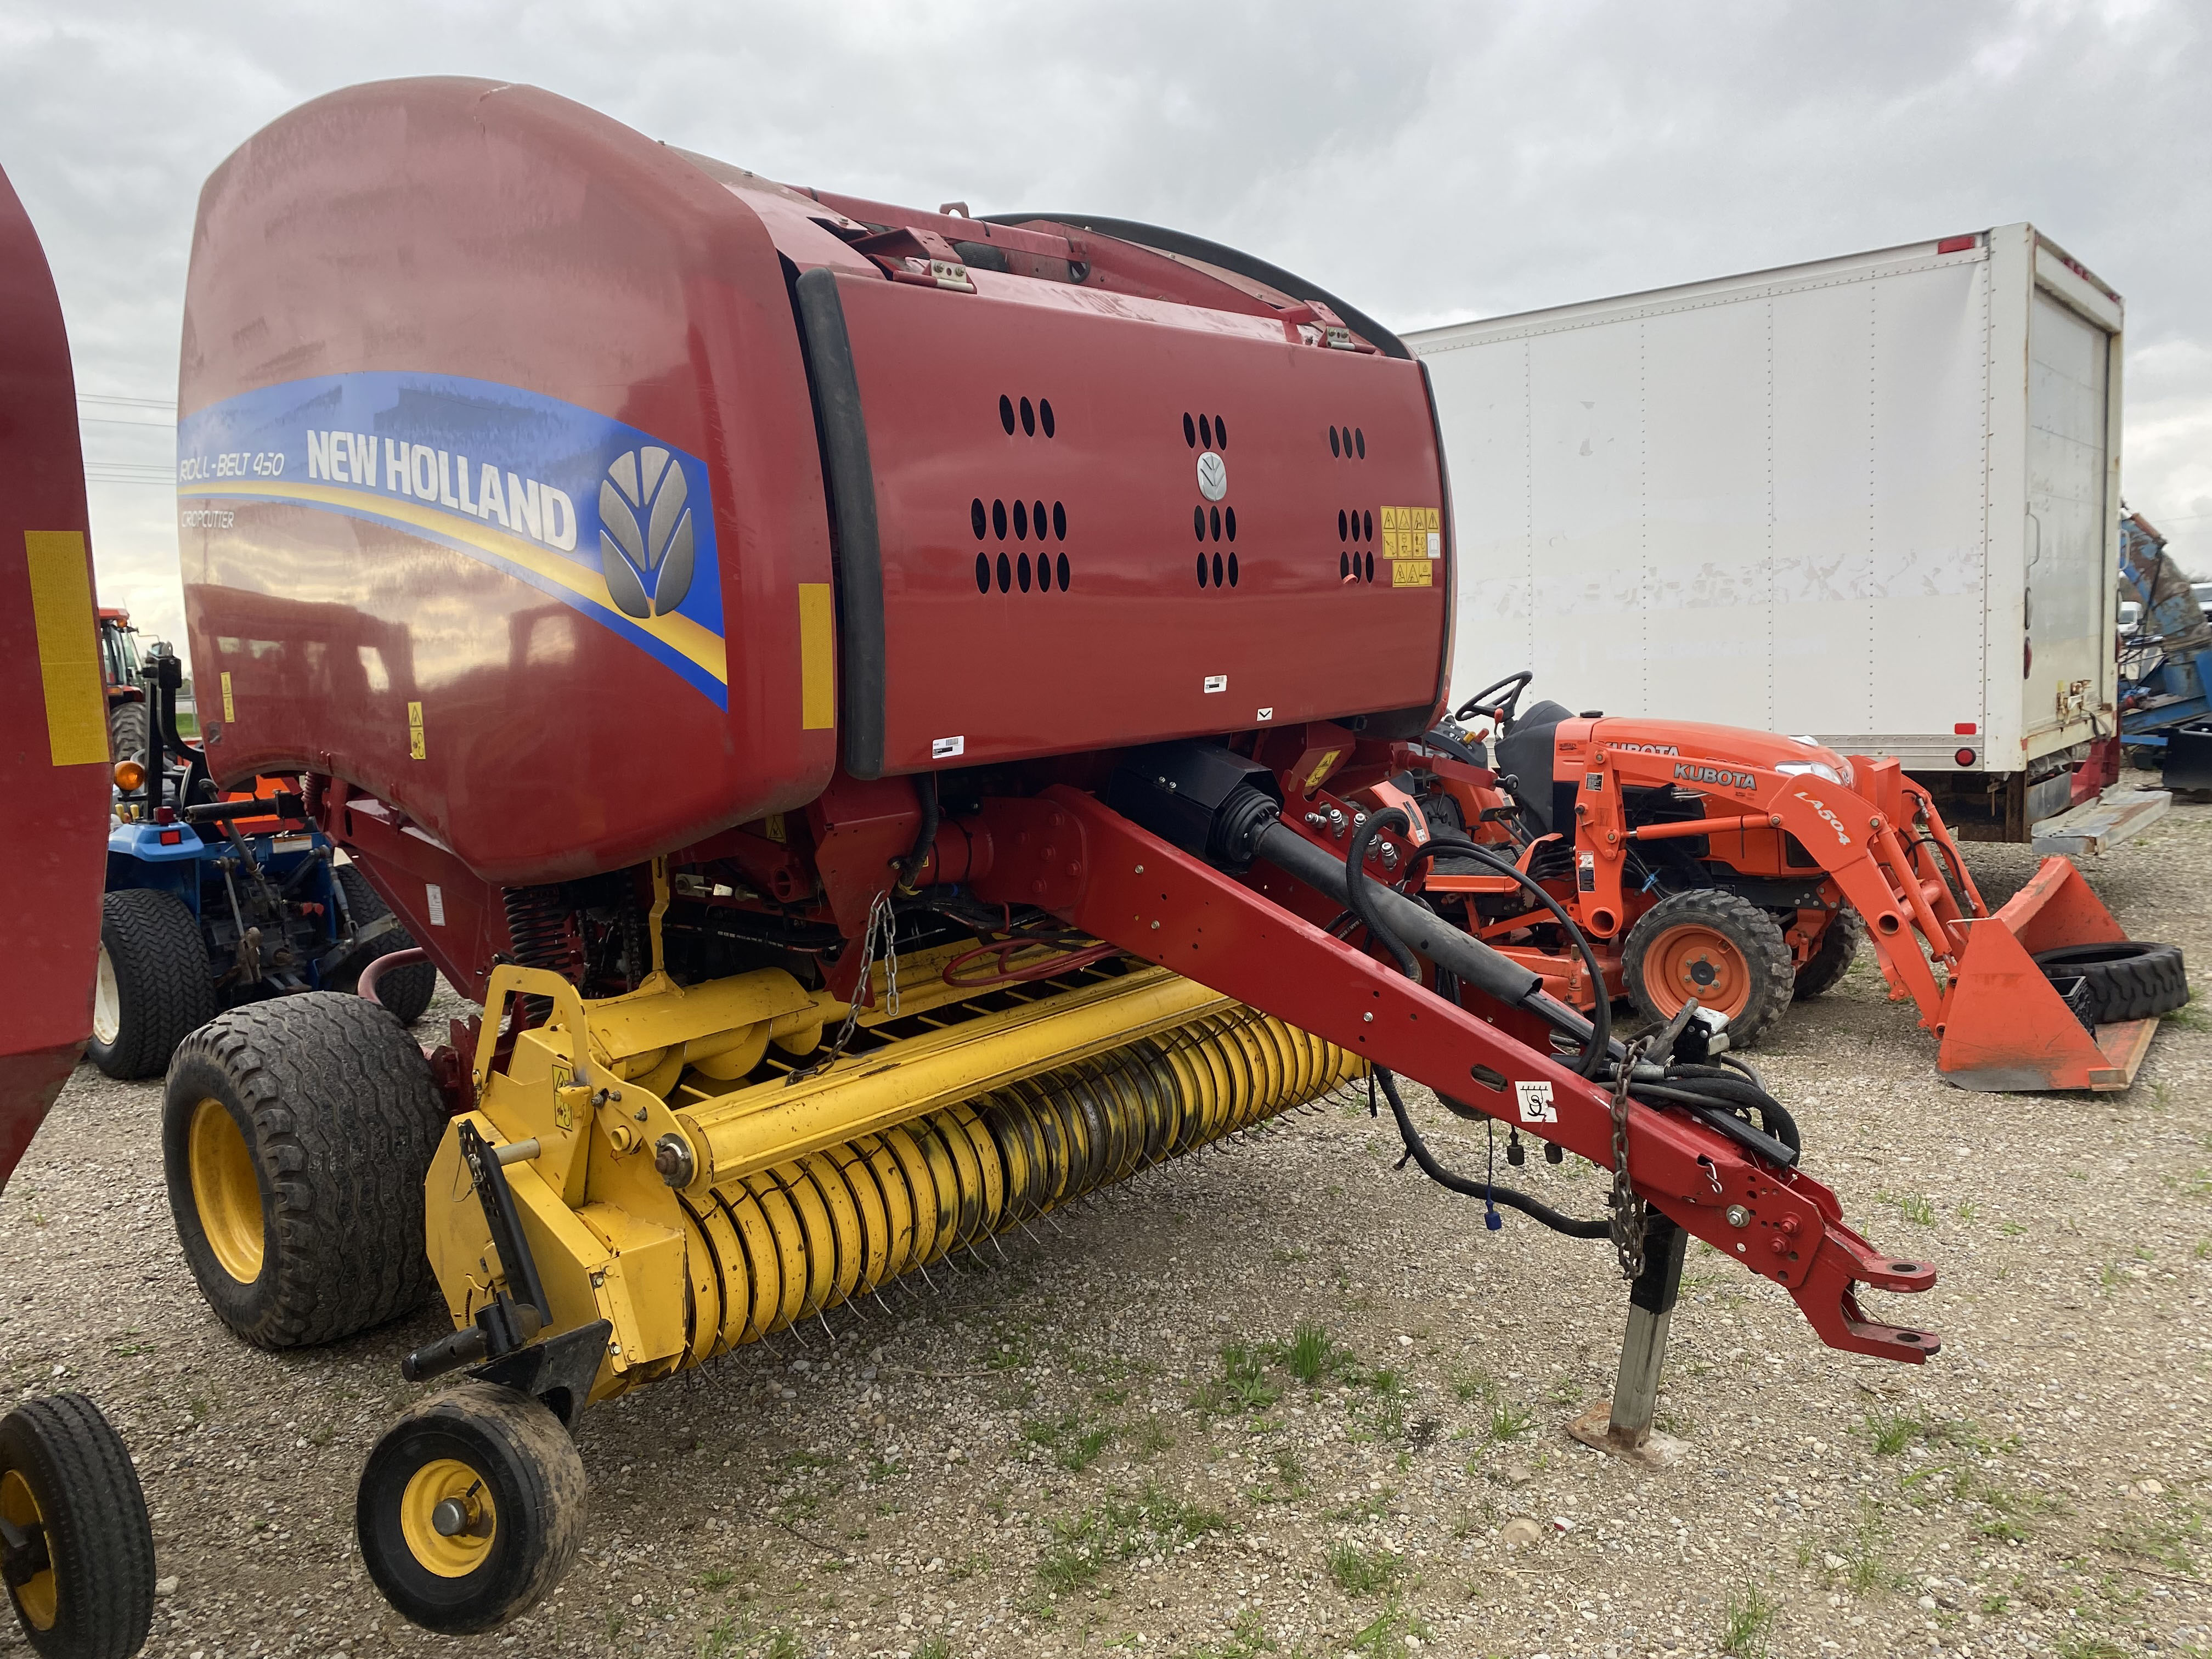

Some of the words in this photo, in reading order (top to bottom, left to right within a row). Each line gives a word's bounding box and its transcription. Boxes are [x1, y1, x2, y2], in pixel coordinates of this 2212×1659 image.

[253, 453, 284, 476] 450
[307, 430, 377, 487] NEW
[385, 438, 577, 551] HOLLAND
[182, 510, 234, 528] CROPCUTTER
[1674, 763, 1757, 791] KUBOTA
[1793, 792, 1851, 845] LA504
